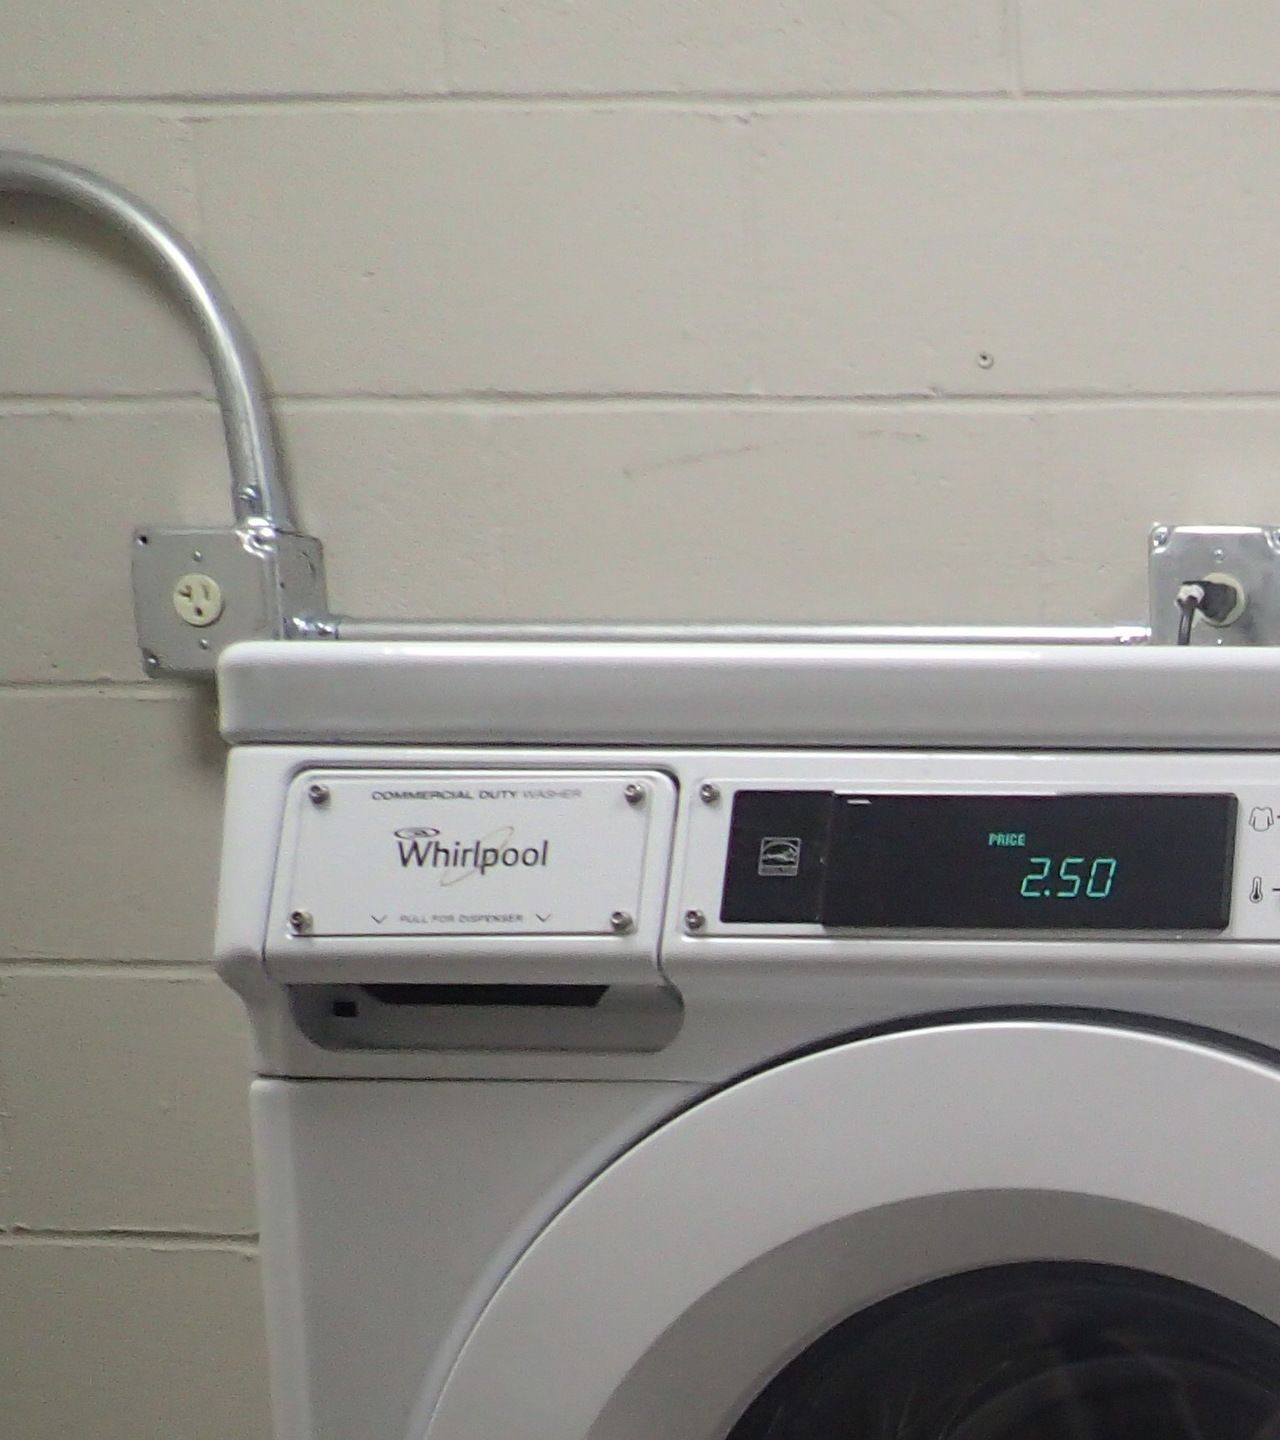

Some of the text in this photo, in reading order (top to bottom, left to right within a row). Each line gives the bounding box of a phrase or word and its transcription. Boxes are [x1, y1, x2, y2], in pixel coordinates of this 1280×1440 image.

[372, 790, 474, 801] COMMERCIAL
[479, 790, 517, 800] DUTY
[988, 832, 1026, 847] PRICE
[397, 839, 548, 875] Whirlpool
[1020, 857, 1117, 897] 2.50
